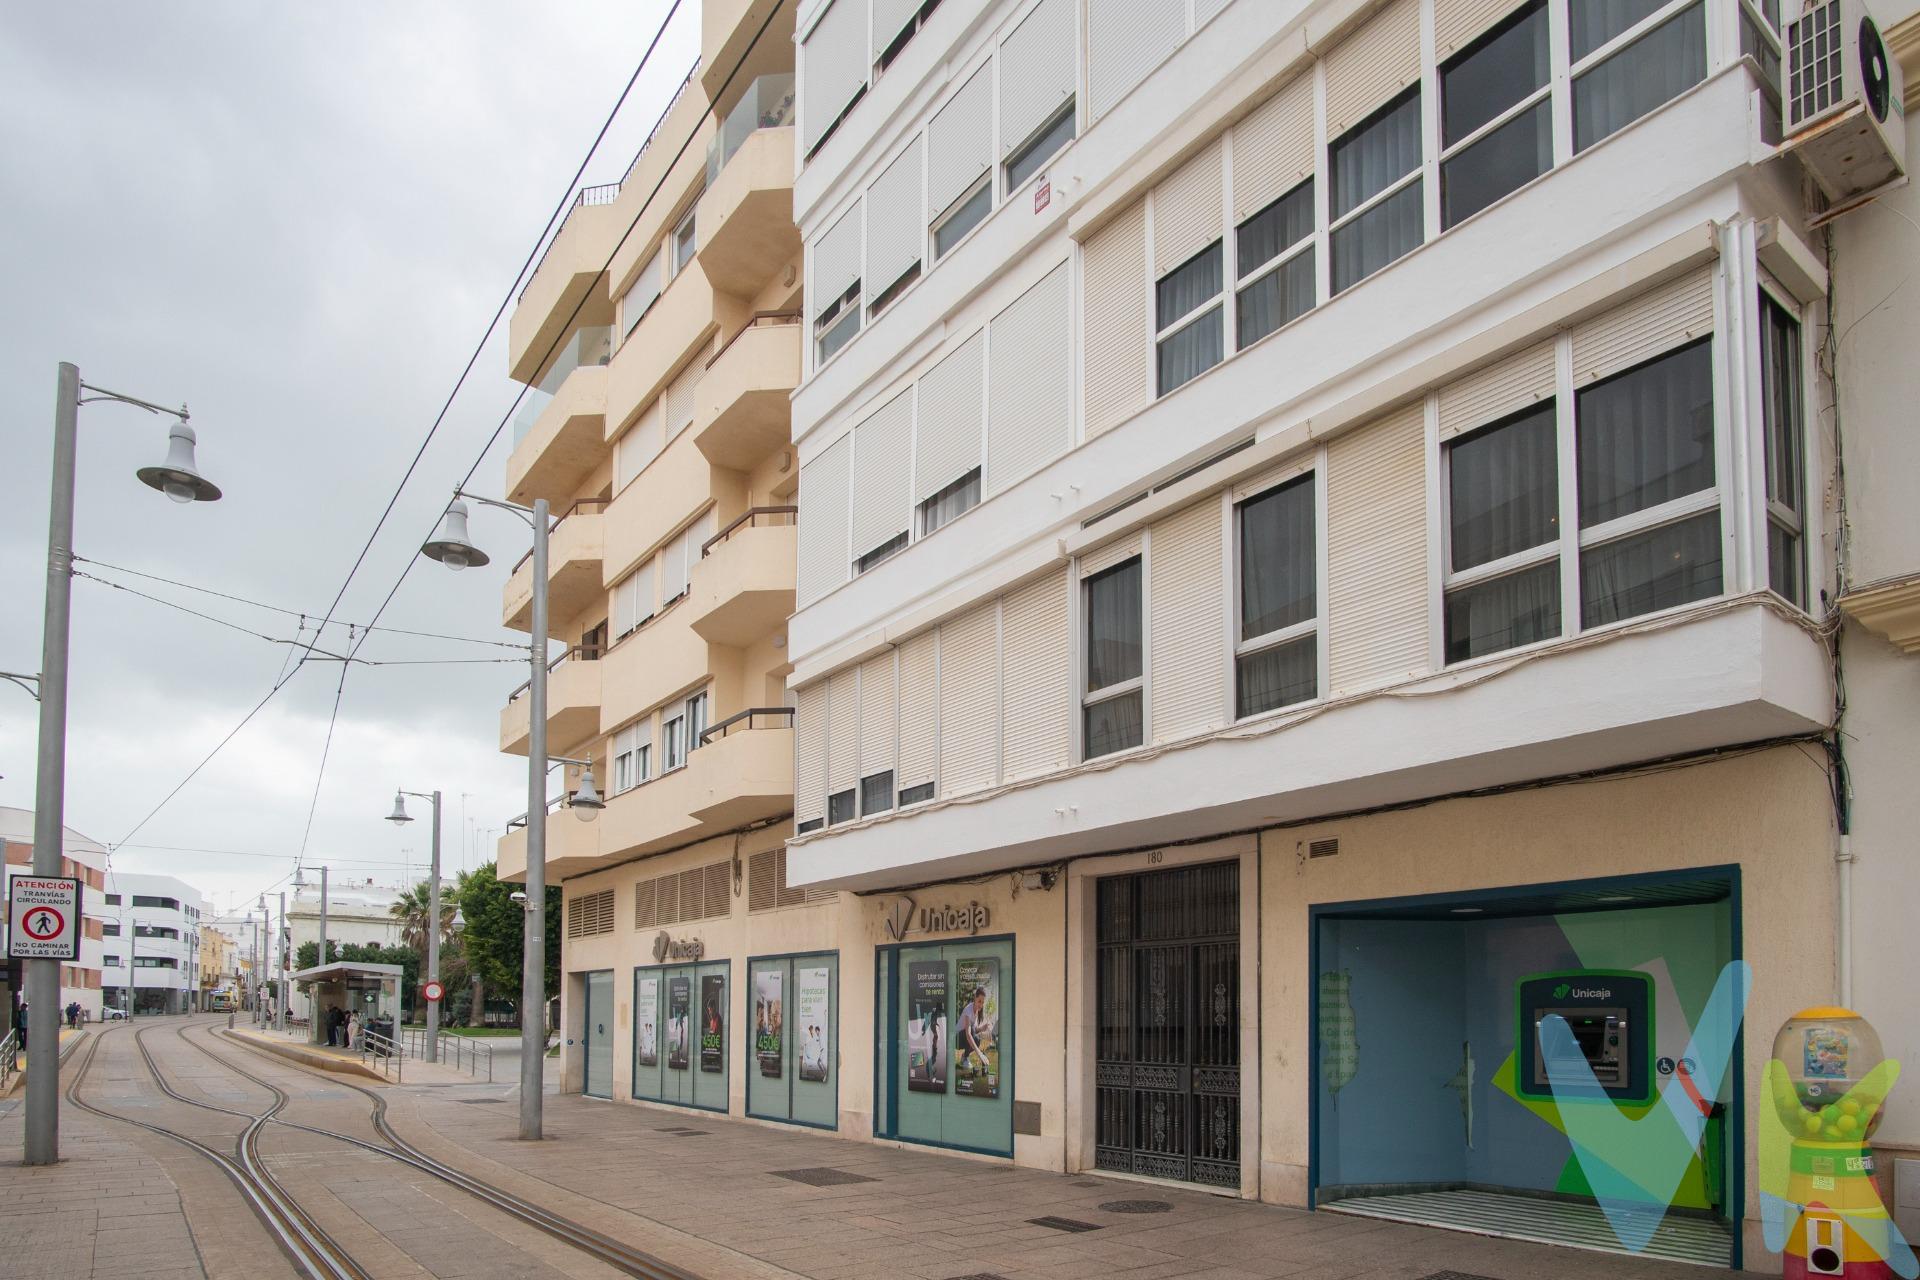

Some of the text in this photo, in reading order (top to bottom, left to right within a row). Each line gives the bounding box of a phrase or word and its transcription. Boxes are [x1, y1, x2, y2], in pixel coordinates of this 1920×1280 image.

[1147, 851, 1163, 864] 180
[16, 880, 74, 890] ATENCIÓN
[24, 890, 65, 898] TRANVÍAS
[17, 897, 71, 905] CIRCULANDO
[920, 901, 990, 935] Unicaja
[669, 936, 704, 962] Unicaja
[1572, 988, 1611, 1000] Unicaja
[758, 1034, 780, 1050] 450€
